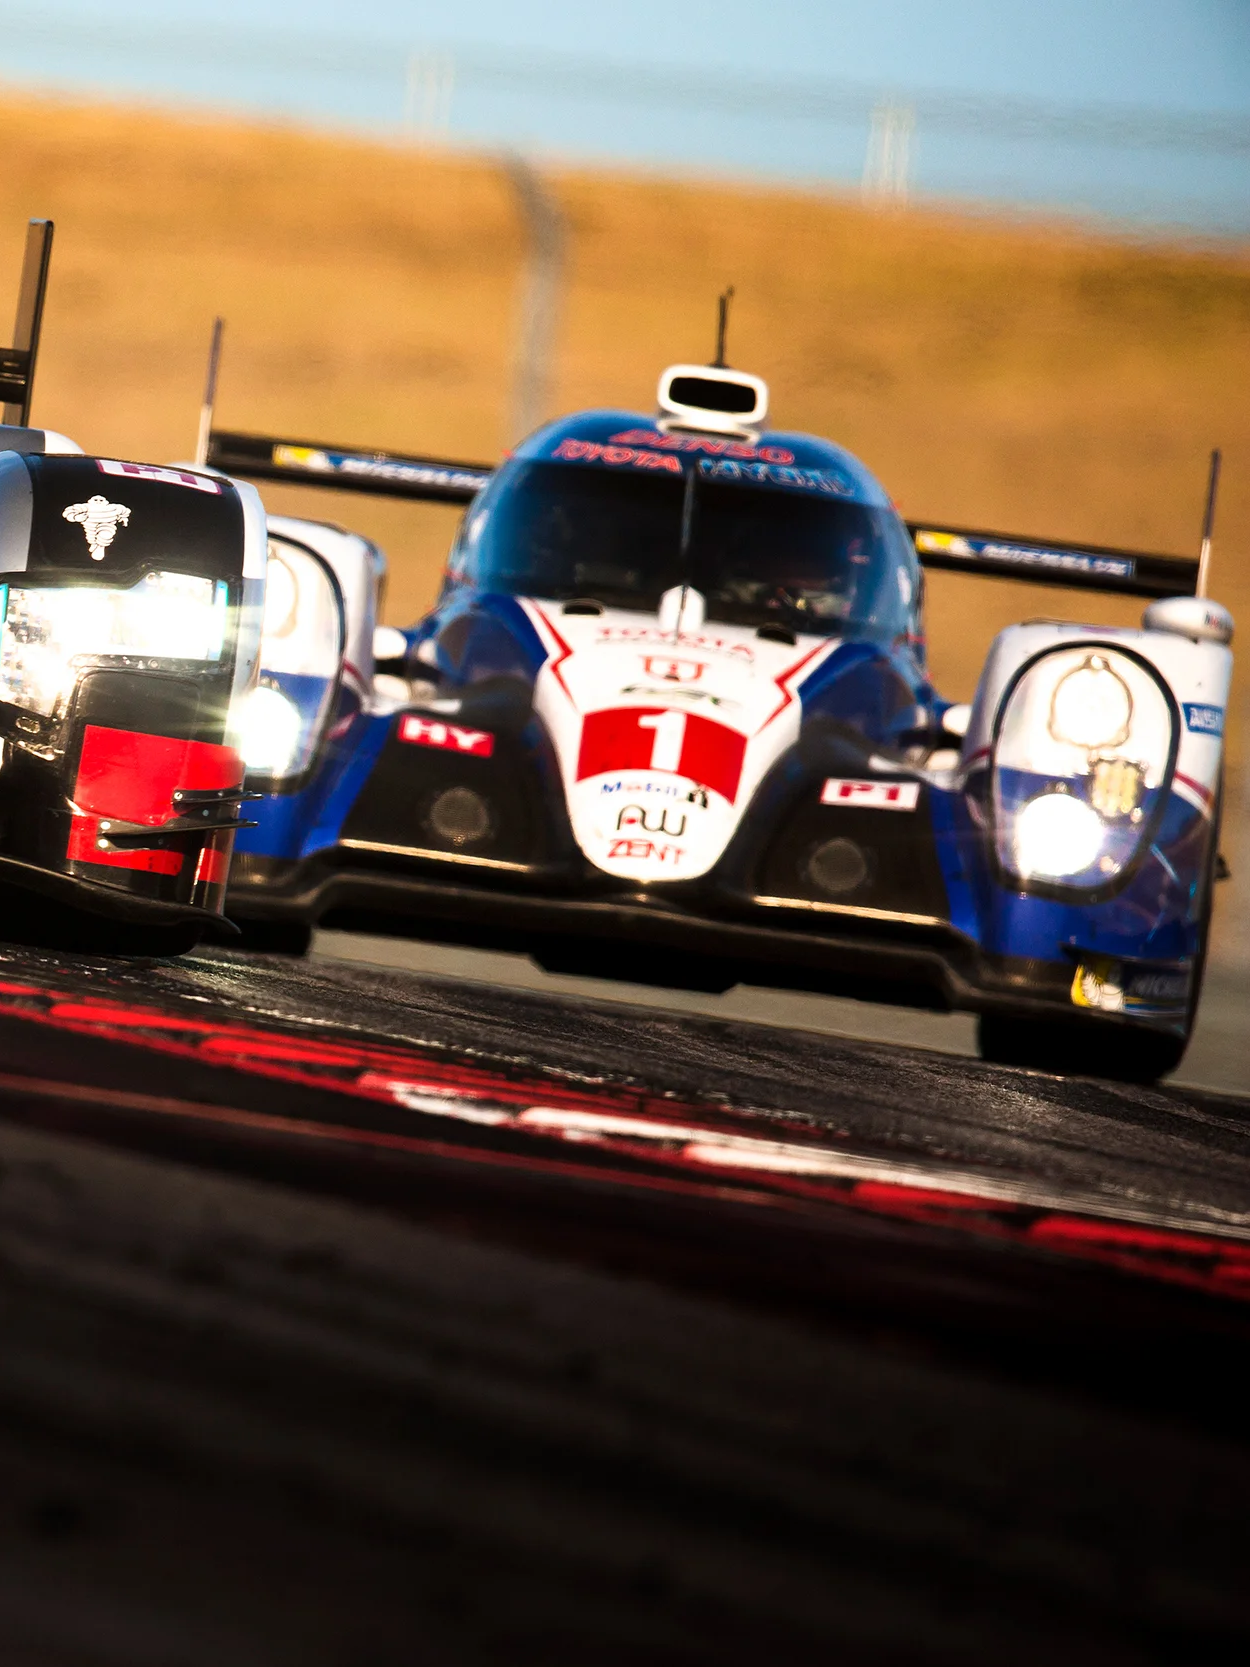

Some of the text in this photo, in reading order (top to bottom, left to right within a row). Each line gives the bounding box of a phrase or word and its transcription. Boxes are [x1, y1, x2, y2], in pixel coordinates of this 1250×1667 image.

[551, 438, 684, 474] TOYOTA
[403, 716, 491, 751] HY
[637, 710, 688, 773] 1
[837, 781, 901, 801] P1
[616, 804, 687, 837] AW
[607, 838, 688, 865] ZENT
